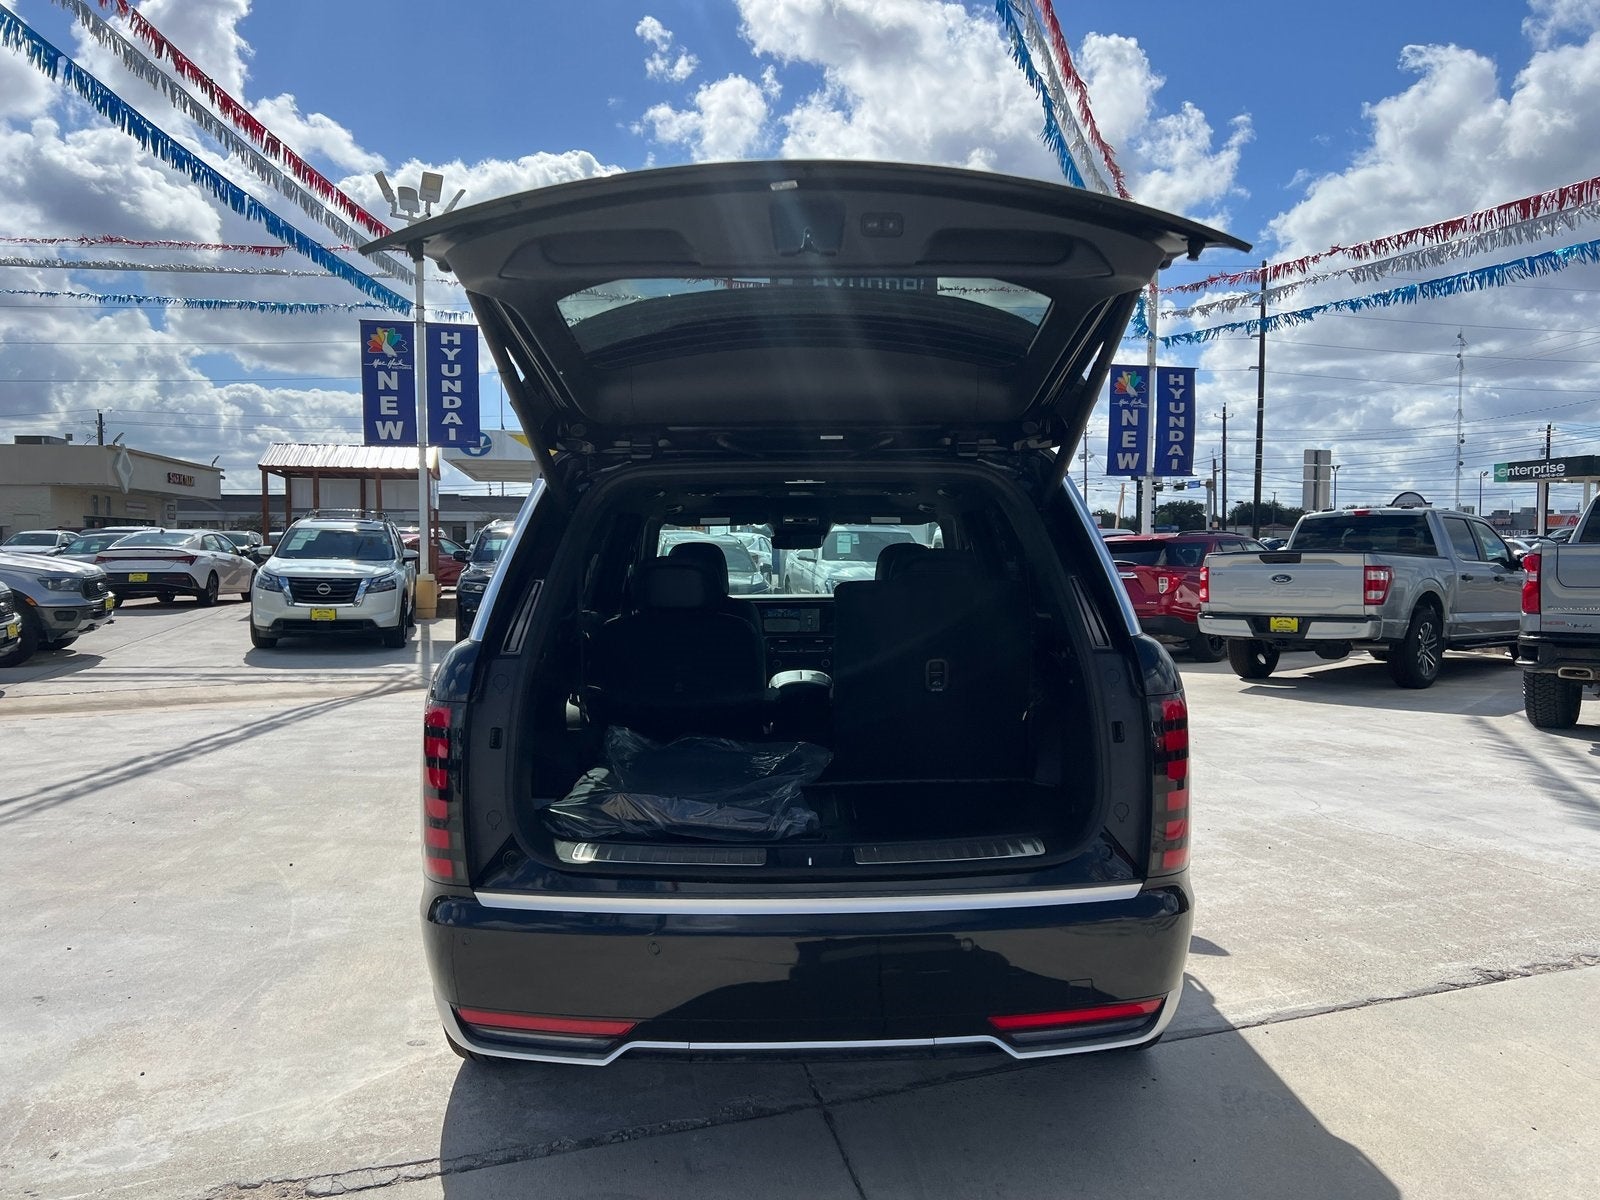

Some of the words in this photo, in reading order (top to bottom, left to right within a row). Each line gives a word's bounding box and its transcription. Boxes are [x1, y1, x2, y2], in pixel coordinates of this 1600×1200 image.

[375, 370, 404, 440] NEW
[440, 331, 463, 441] HYUNDAI
[1117, 409, 1140, 470] NEW
[1167, 374, 1185, 470] HYUNDAI
[1495, 462, 1566, 478] enterprise
